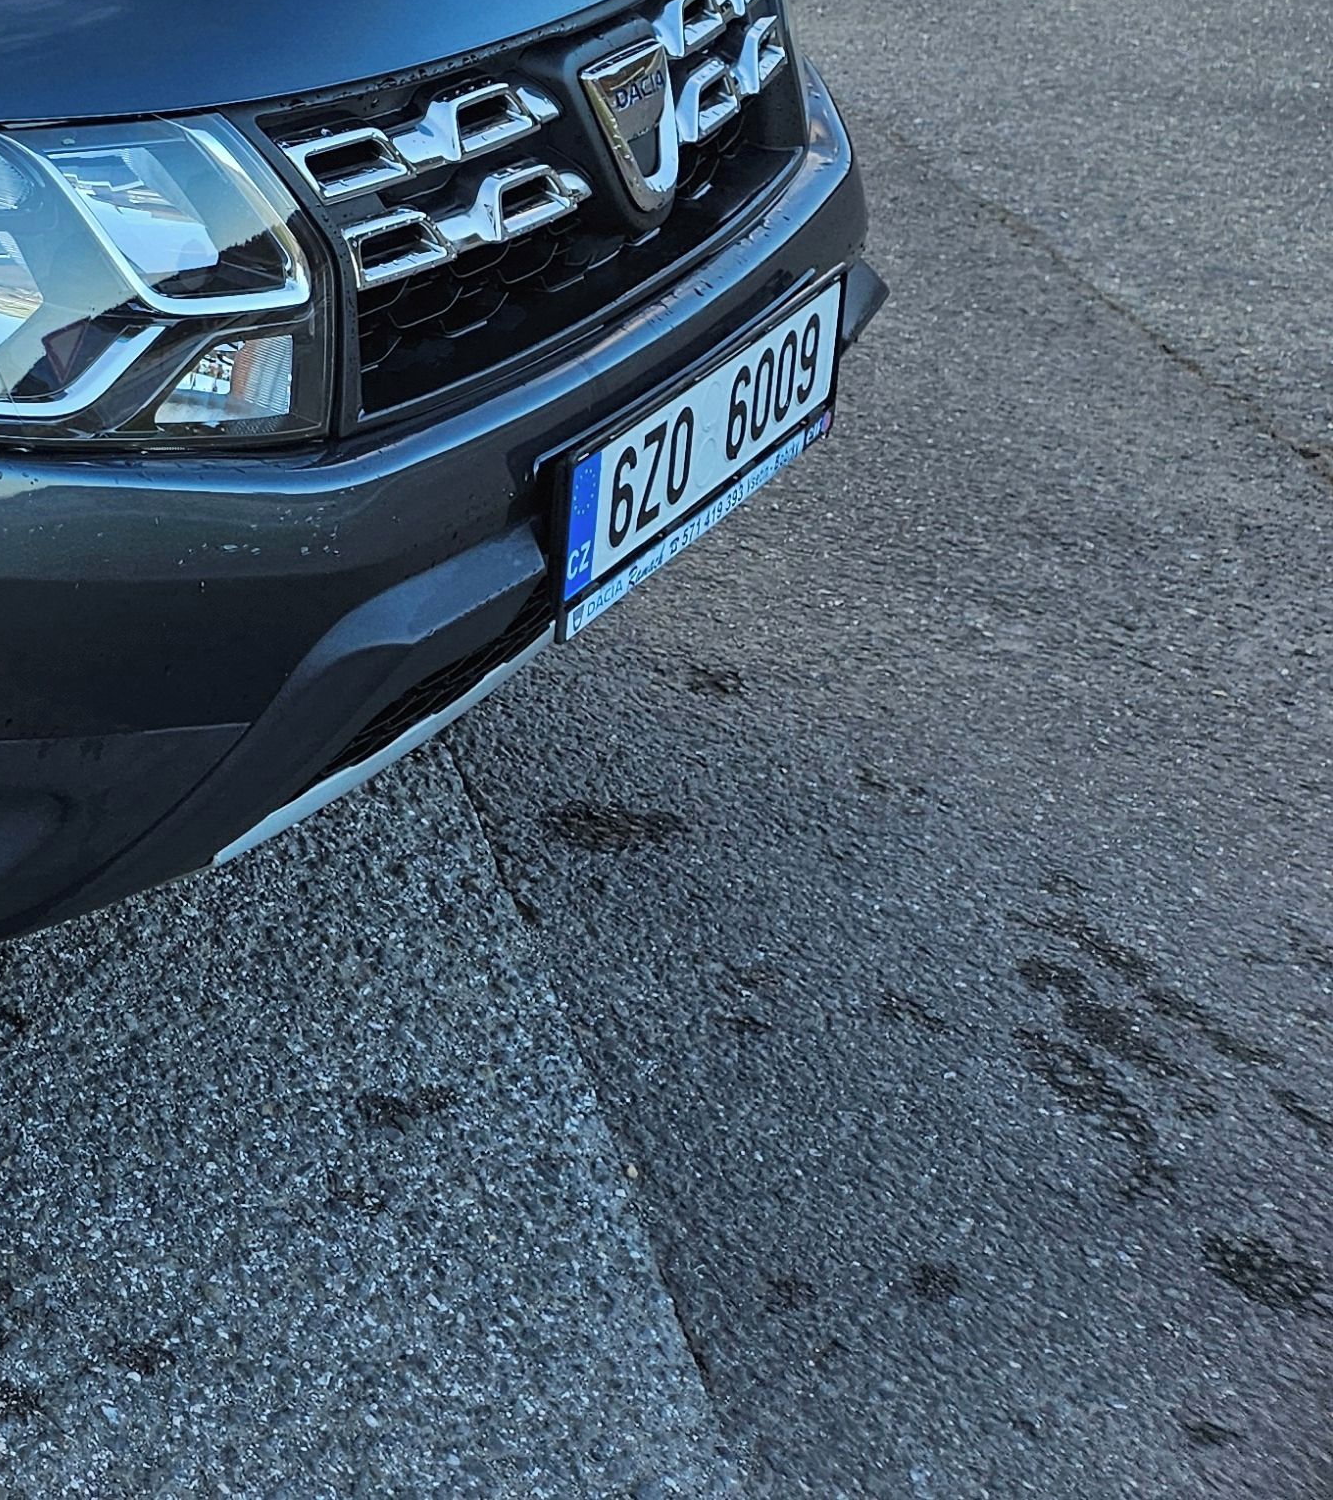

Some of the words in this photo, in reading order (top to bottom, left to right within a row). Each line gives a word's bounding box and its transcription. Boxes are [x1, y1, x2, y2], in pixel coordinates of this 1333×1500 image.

[615, 70, 664, 108] DACIA
[726, 313, 821, 461] 6009
[566, 540, 591, 580] CZ
[587, 580, 623, 617] DACIA
[681, 522, 701, 545] 571
[704, 501, 723, 527] 419
[725, 484, 744, 511] 393
